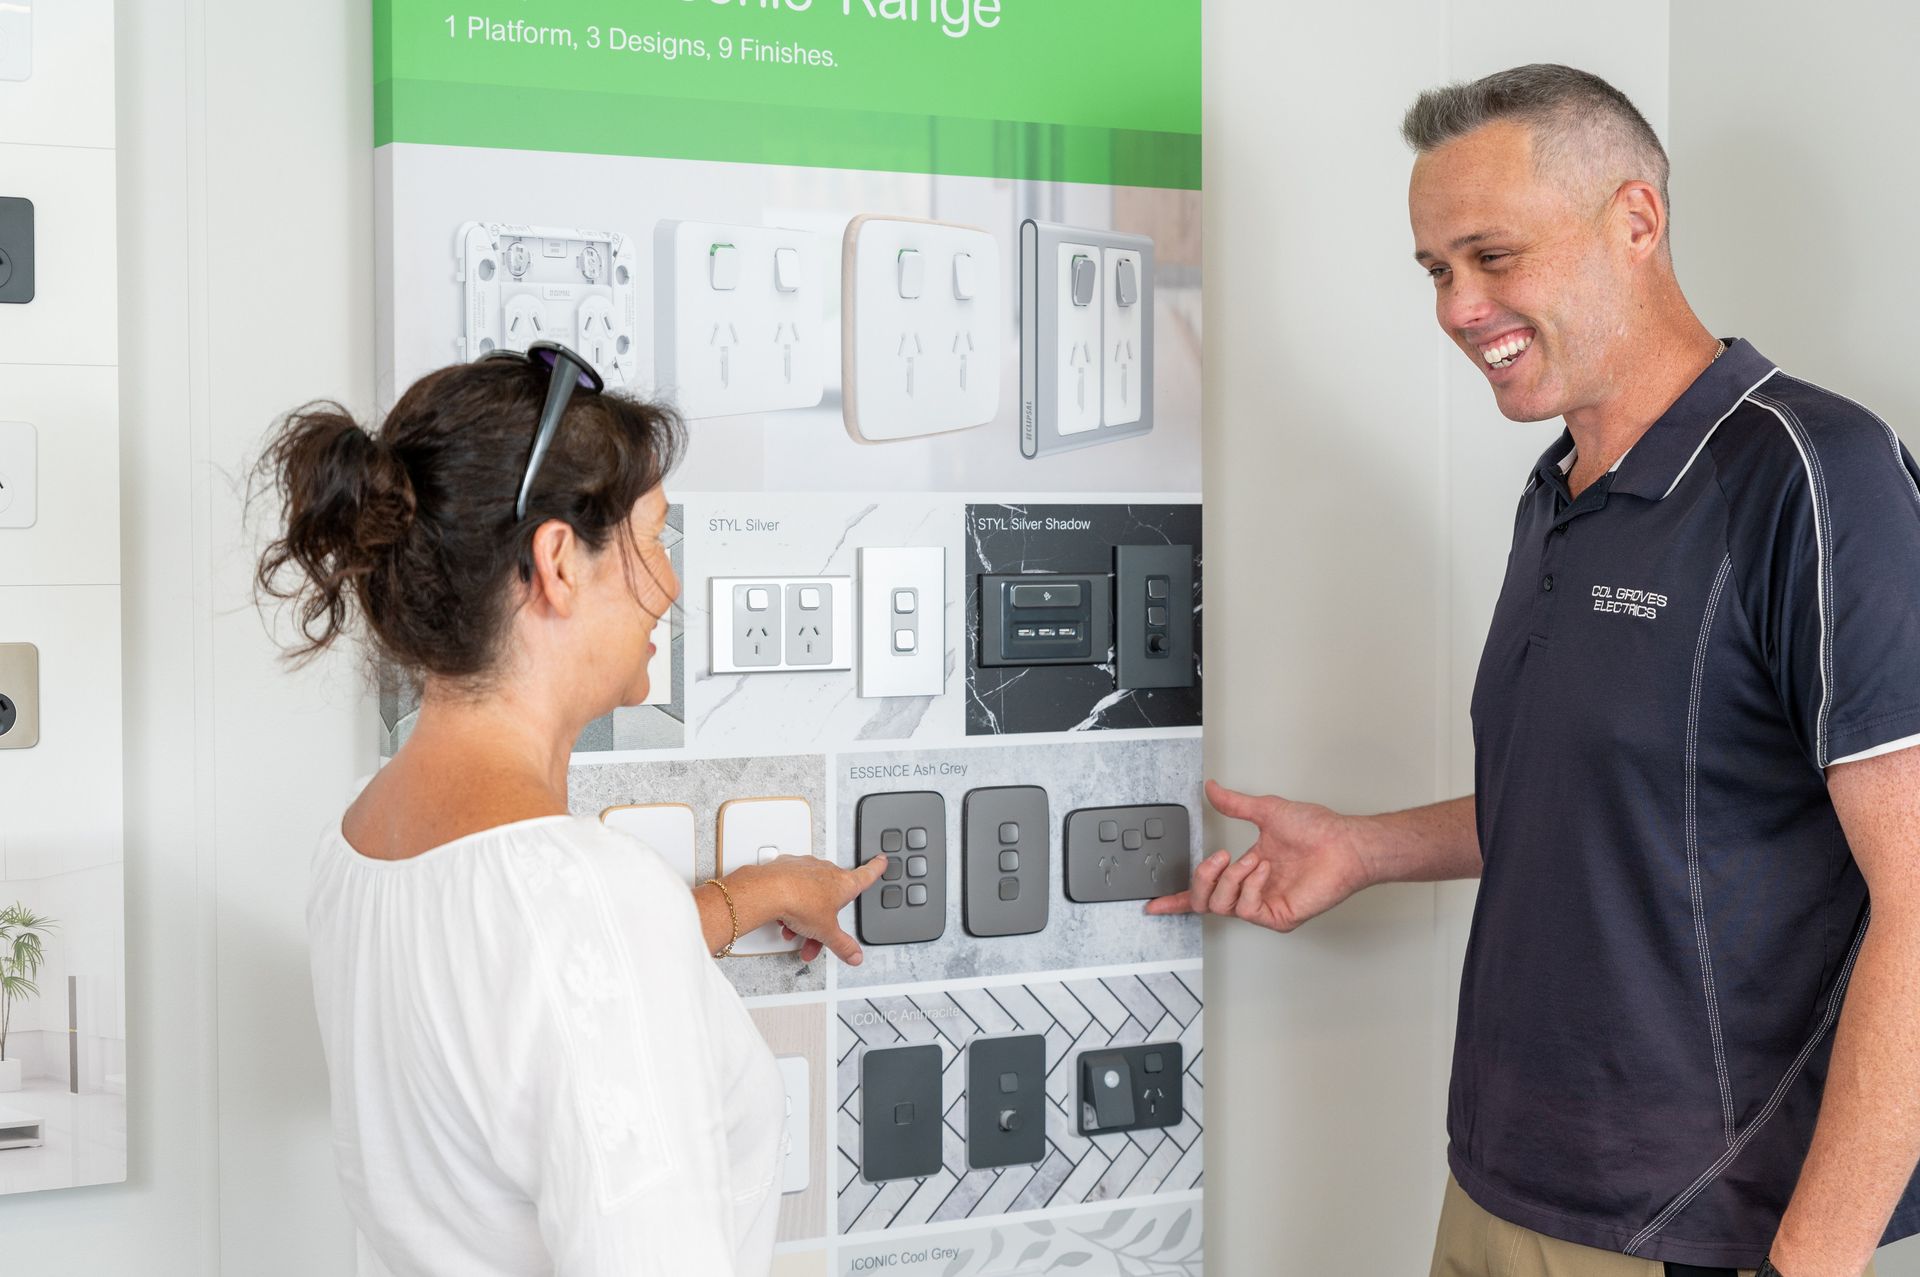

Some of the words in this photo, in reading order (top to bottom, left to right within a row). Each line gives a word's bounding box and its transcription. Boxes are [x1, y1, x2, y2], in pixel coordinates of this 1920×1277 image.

[445, 15, 455, 38] 1
[468, 16, 578, 50] Platform,
[586, 26, 601, 48] 3
[609, 27, 711, 60] Designs,
[718, 37, 733, 59] 9
[741, 38, 839, 67] Finishes.
[709, 518, 742, 531] STYL
[746, 518, 780, 531] Silver
[978, 518, 1008, 530] STYL
[1011, 518, 1042, 530] Silver
[1045, 517, 1091, 530] Shadow
[1591, 585, 1612, 598] COL
[1616, 587, 1668, 607] GROVES
[1593, 599, 1657, 619] ELECTRICS
[850, 764, 910, 779] ESSENCE
[913, 763, 936, 776] Ash
[940, 762, 968, 776] Grey
[851, 1010, 897, 1025] ICONIC
[901, 1006, 960, 1021] Anthracite
[851, 1253, 898, 1271] ICONIC
[901, 1249, 928, 1264] Cool
[931, 1247, 960, 1260] Grey
